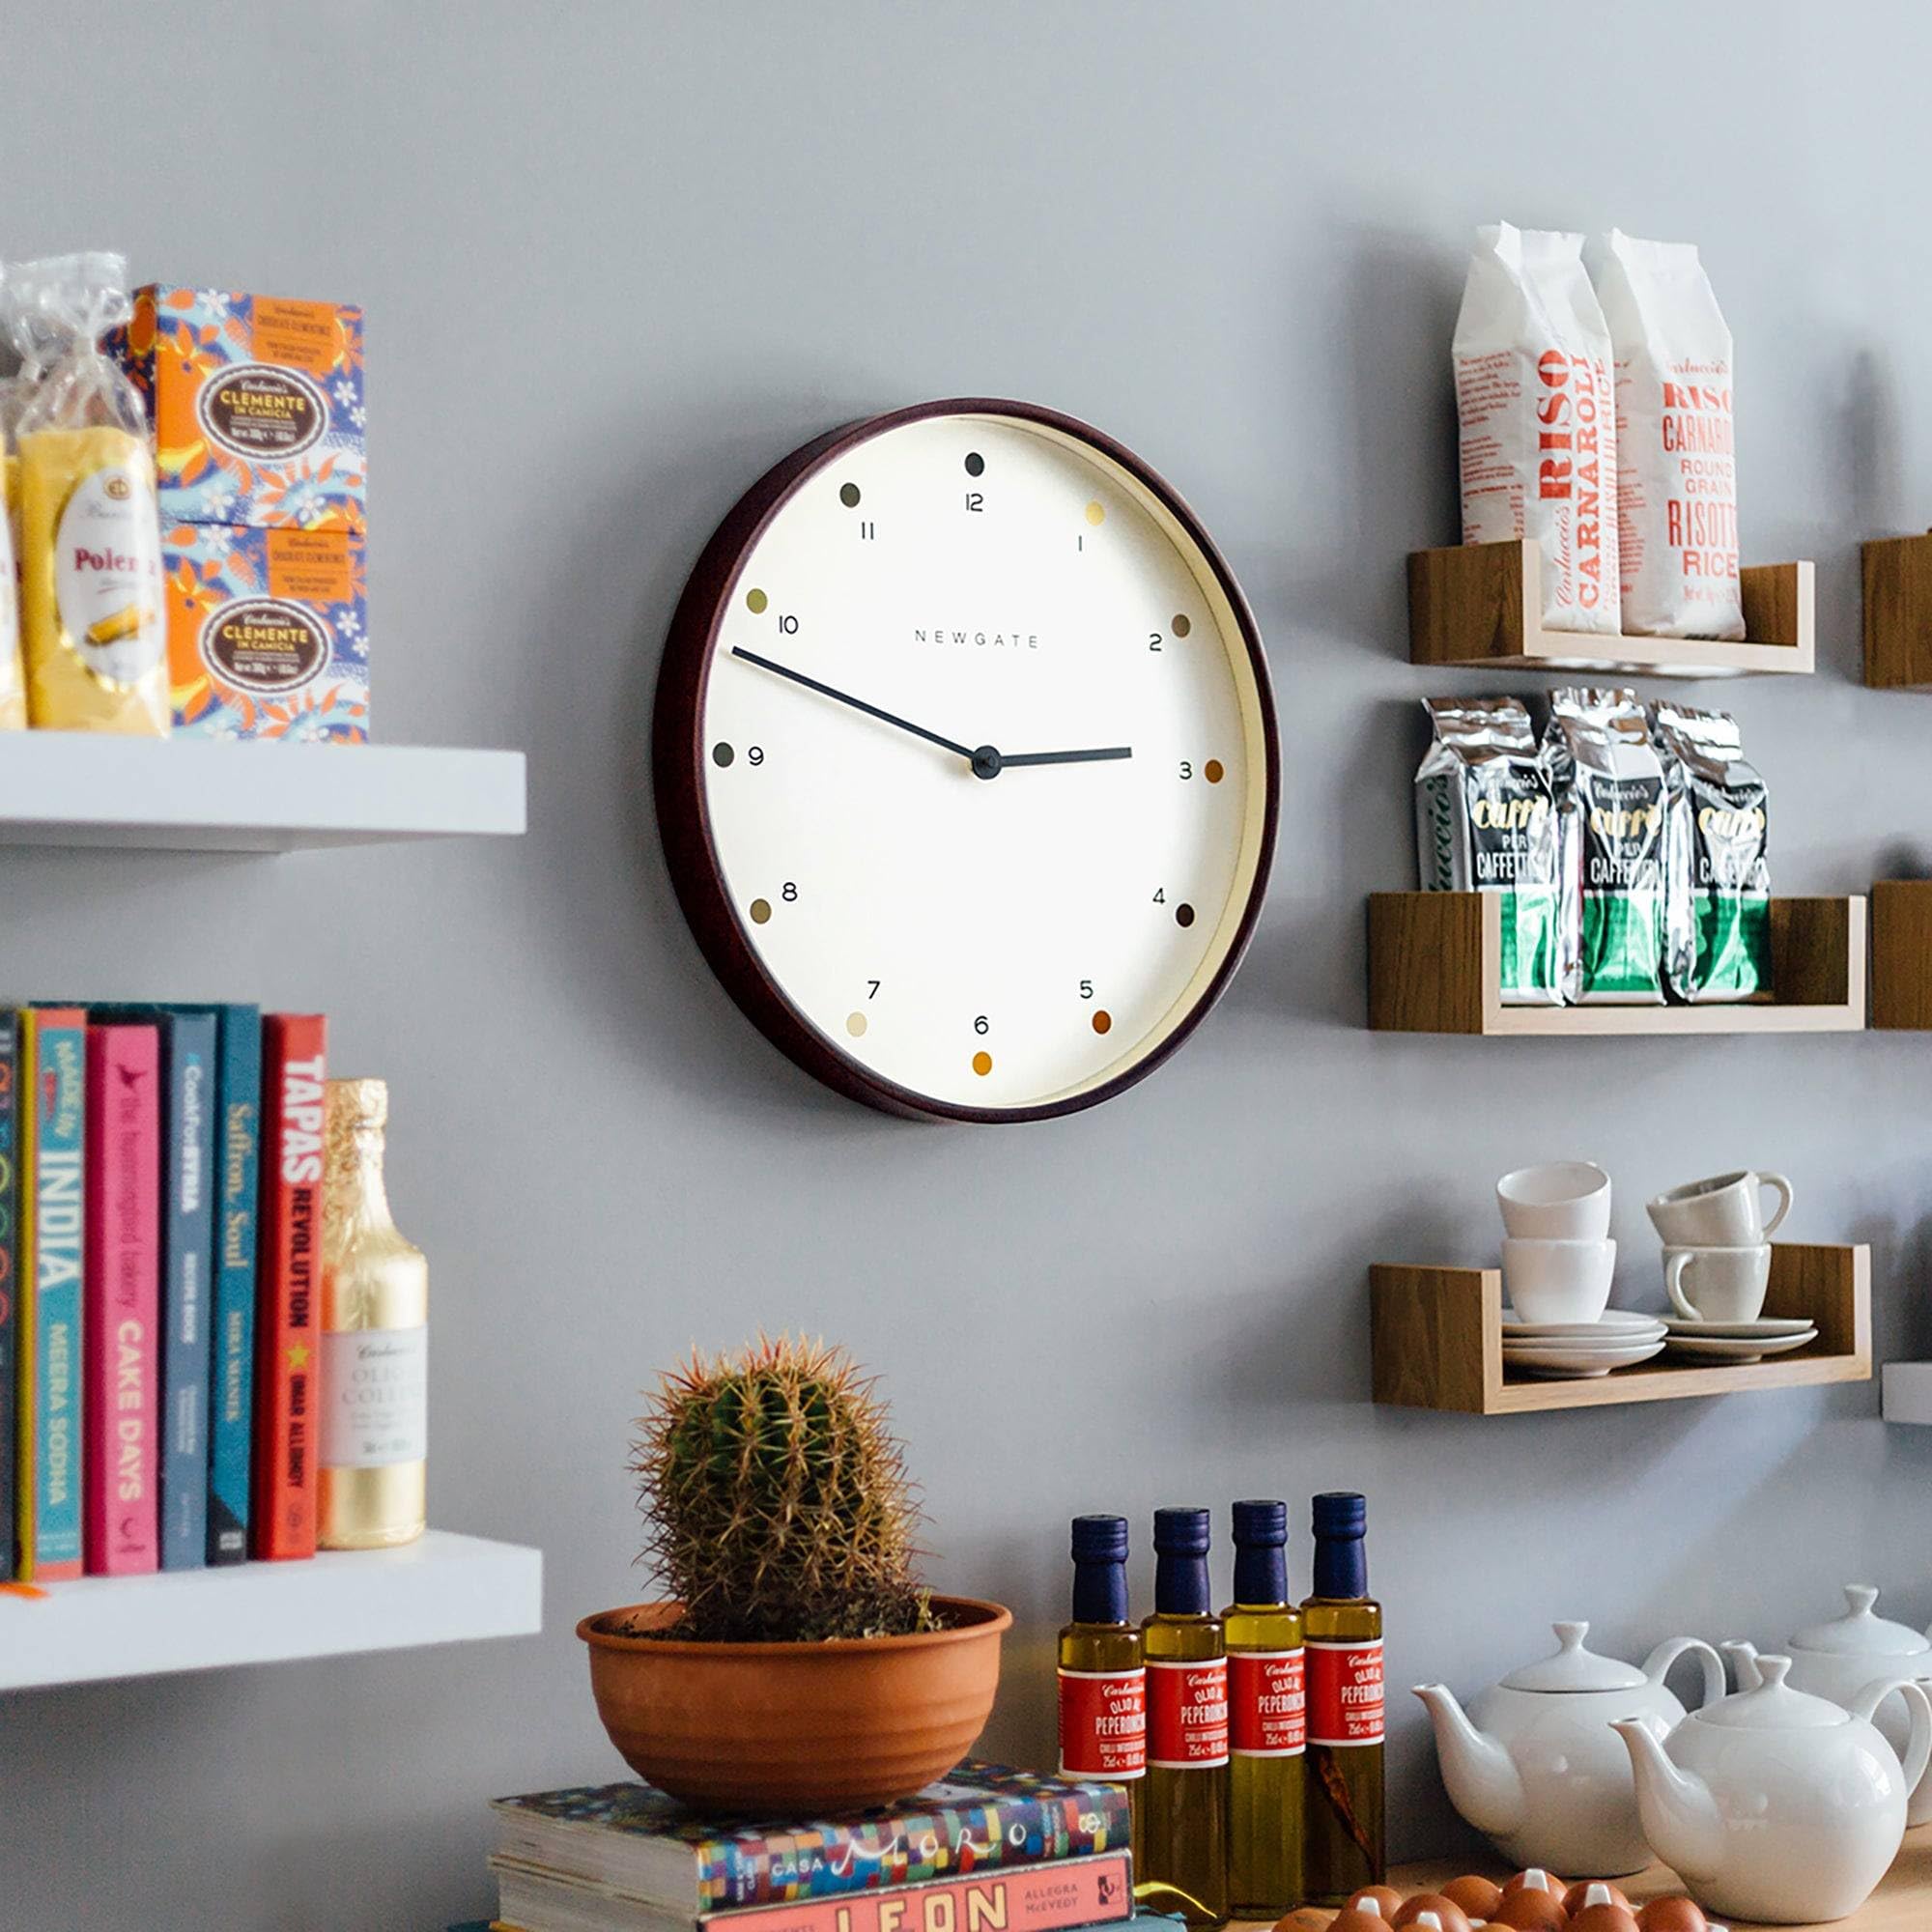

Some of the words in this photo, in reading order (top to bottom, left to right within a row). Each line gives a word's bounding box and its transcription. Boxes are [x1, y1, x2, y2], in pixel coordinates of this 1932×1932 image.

[219, 389, 305, 412] CLEMENTE
[1536, 349, 1573, 500] RISO
[1573, 354, 1601, 609] CARNAROLI
[966, 493, 984, 512] 12
[861, 522, 874, 540] 11
[1683, 550, 1738, 580] RICE
[222, 625, 308, 643] CLEMENTE
[779, 615, 799, 635] 10
[915, 630, 1040, 648] NEWGATE
[1150, 633, 1163, 651] 2
[748, 746, 765, 766] 9
[1179, 761, 1193, 780] 3
[781, 882, 799, 902] 8
[1151, 888, 1165, 904] 4
[867, 980, 881, 999] 7
[1080, 980, 1094, 999] 5
[974, 1015, 990, 1035] 6
[282, 1054, 326, 1183] TAPAS
[226, 1103, 253, 1203] Saffron
[39, 1151, 80, 1289] INDIA
[224, 1210, 249, 1268] Soul
[290, 1187, 313, 1328] REVOLUTION
[49, 1323, 69, 1411] MEERA
[118, 1320, 143, 1410] CAKE
[49, 1417, 69, 1506] SODHA
[118, 1419, 143, 1503] DAYS
[773, 1859, 823, 1876] CASA
[831, 1823, 1026, 1875] MORO
[1025, 1884, 1078, 1900] ALLEGRA
